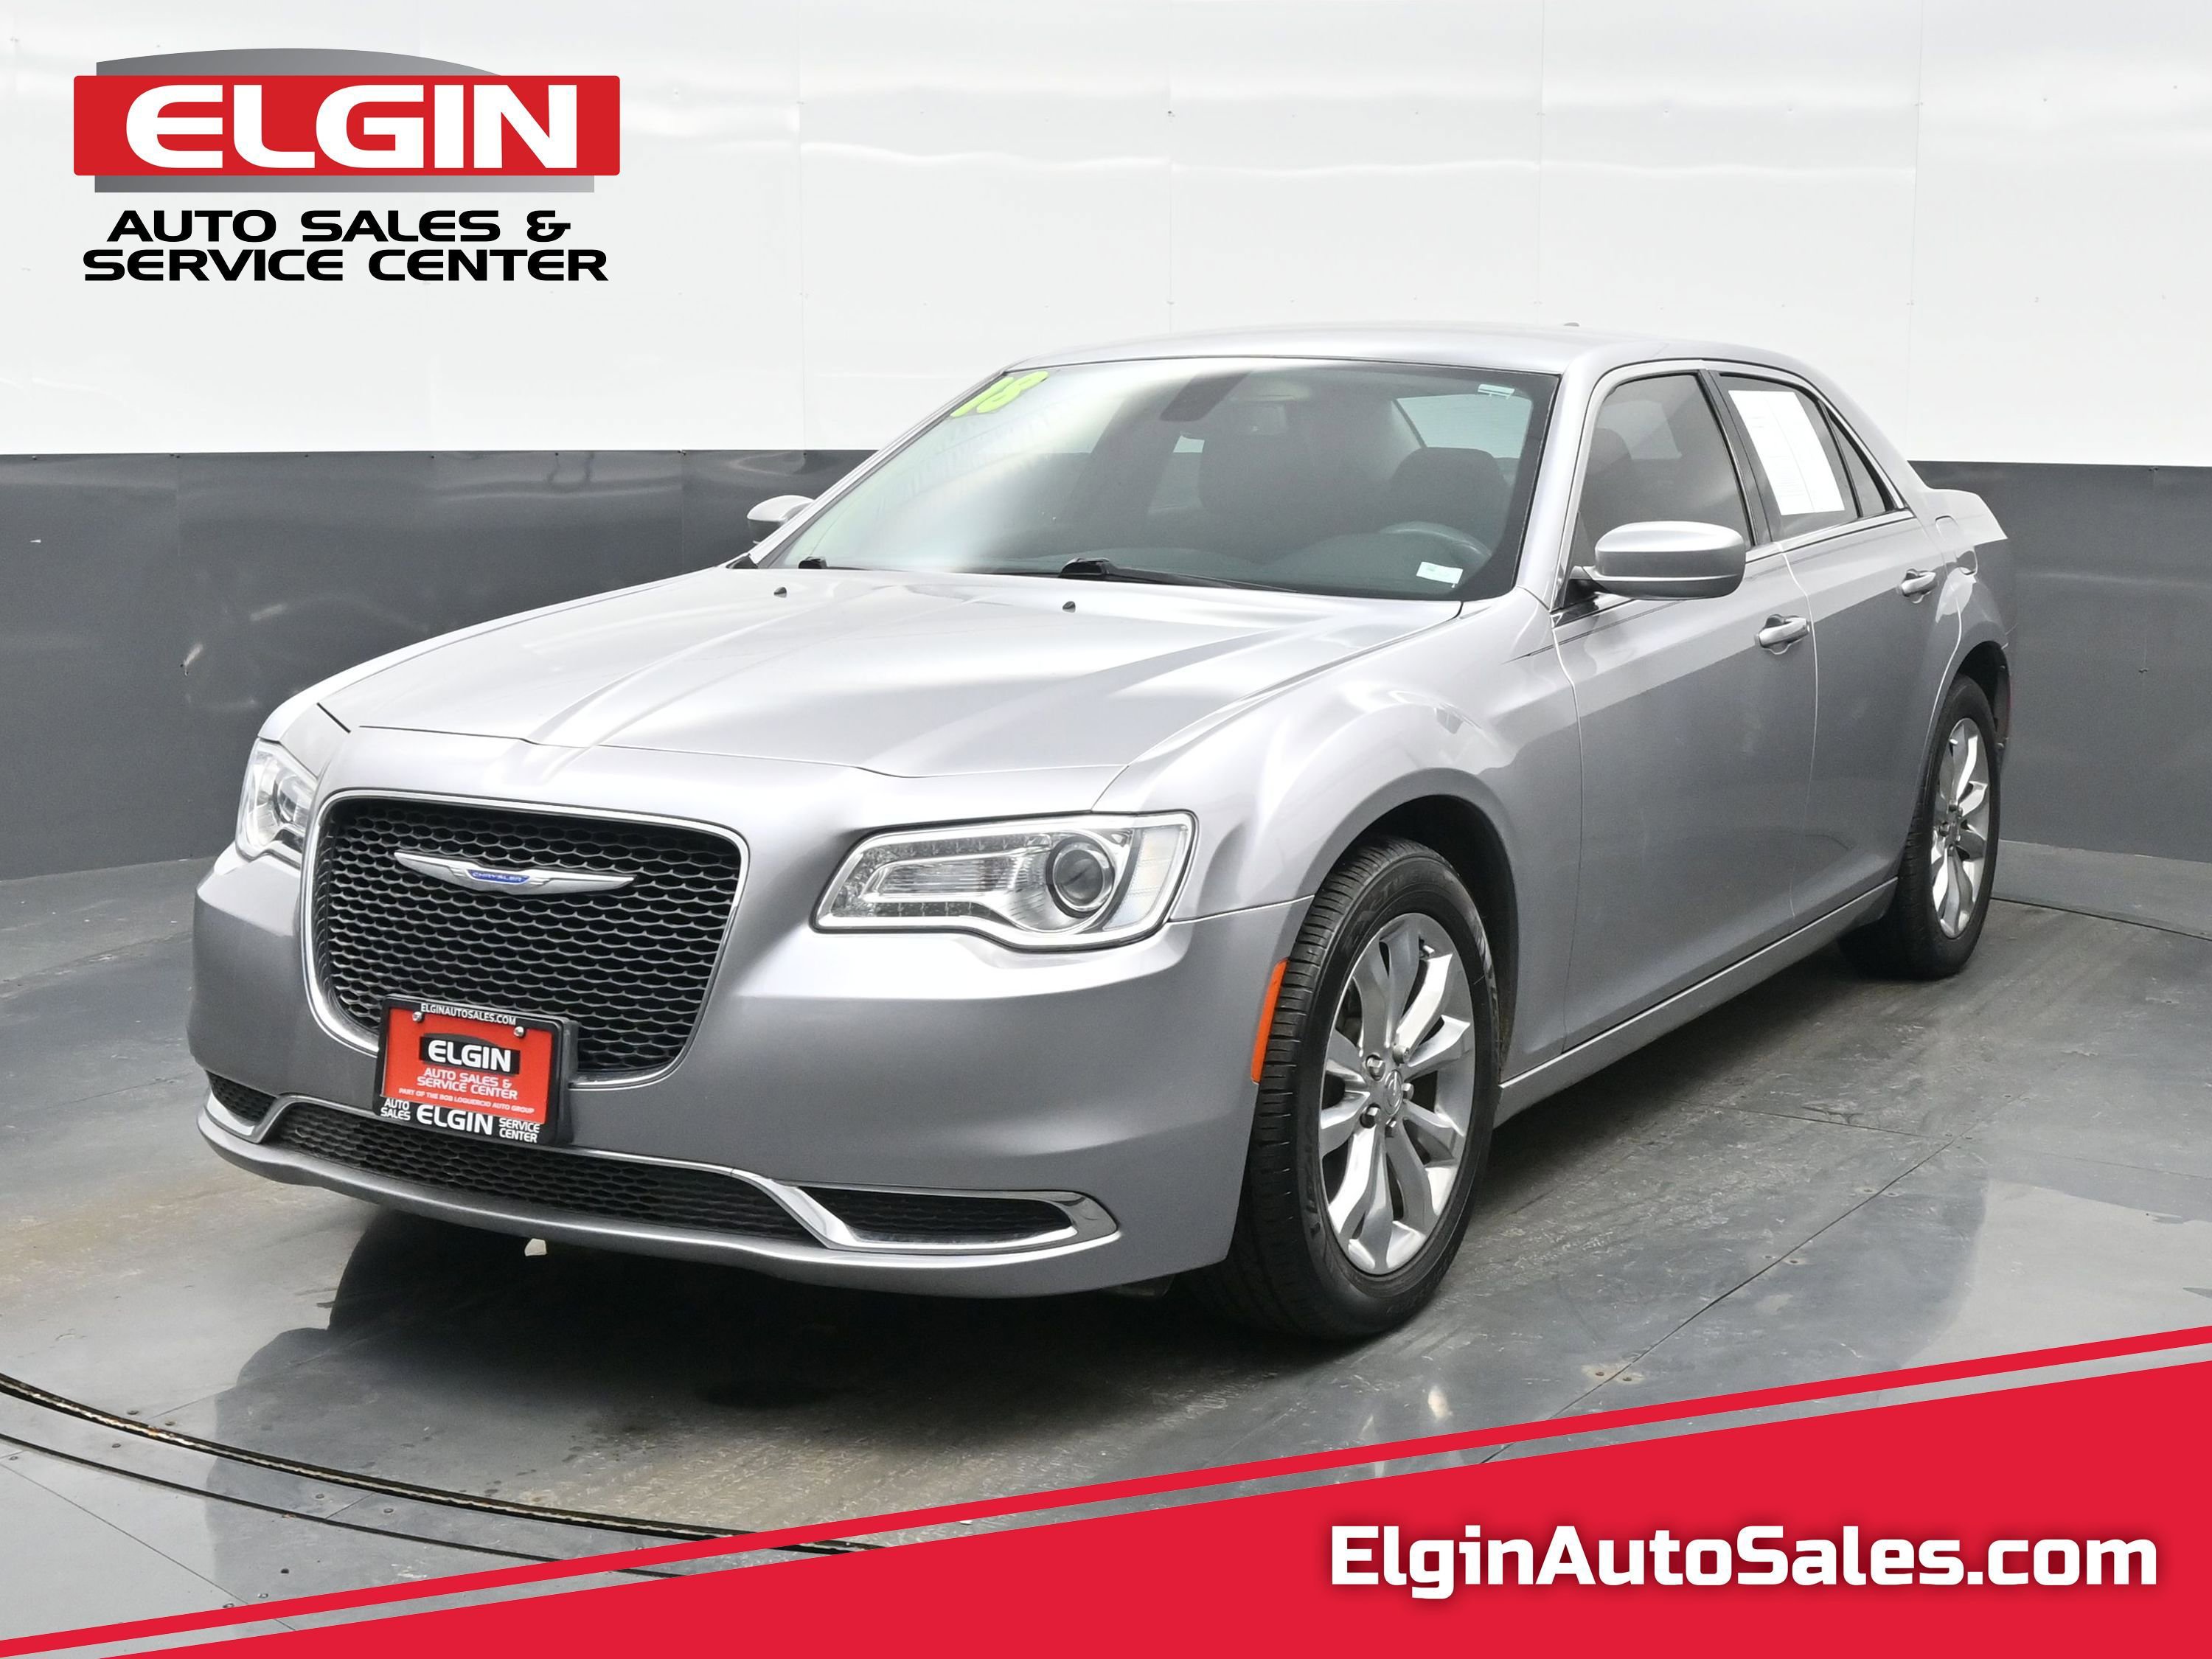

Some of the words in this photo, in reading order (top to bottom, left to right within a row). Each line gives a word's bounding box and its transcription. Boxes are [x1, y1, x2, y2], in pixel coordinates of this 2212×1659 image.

[472, 872, 522, 882] CHRYSLER
[421, 1003, 516, 1026] ELGINAUTOSALES.COM
[428, 1040, 511, 1072] ELGIN
[423, 1068, 456, 1081] AUTO
[459, 1072, 498, 1087] SALES
[503, 1079, 512, 1088] &
[417, 1076, 467, 1093] SERVICE
[470, 1085, 518, 1100] CENTER
[384, 1098, 410, 1111] AUTO
[492, 1102, 510, 1110] AUTO
[511, 1105, 535, 1114] GROUP
[380, 1107, 411, 1121] SALES
[417, 1104, 493, 1135] ELGIN
[499, 1117, 540, 1133] SERVICE
[499, 1128, 538, 1143] CENTER
